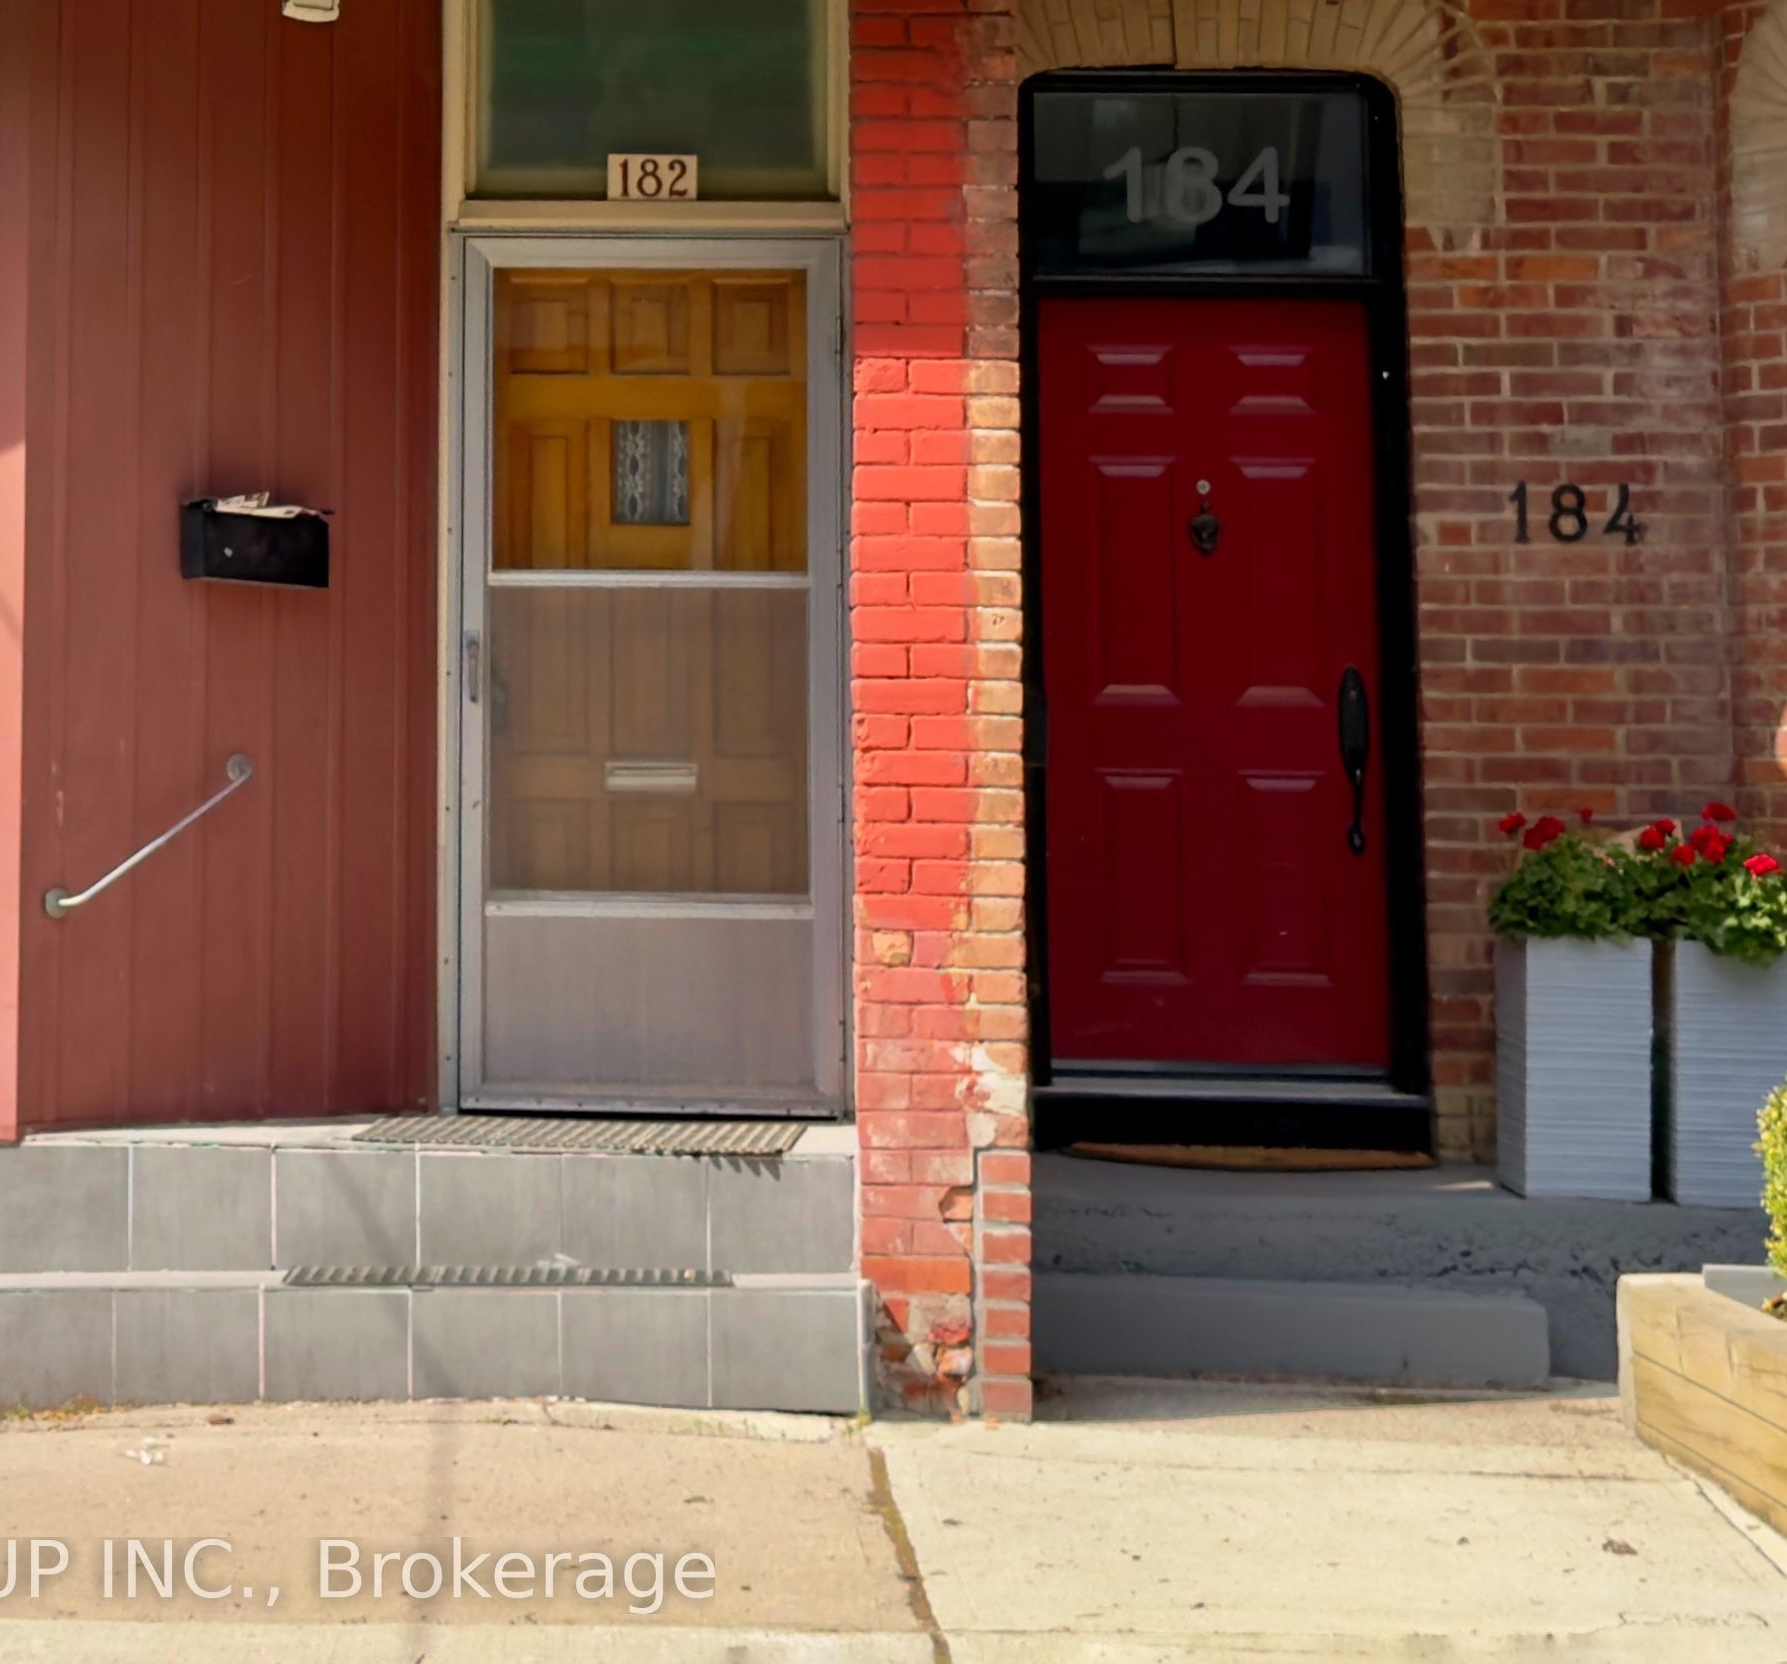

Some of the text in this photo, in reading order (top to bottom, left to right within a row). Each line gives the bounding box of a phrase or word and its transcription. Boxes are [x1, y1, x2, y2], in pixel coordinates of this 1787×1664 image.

[618, 157, 689, 198] 182
[1103, 146, 1291, 224] 184
[1509, 480, 1650, 546] 184
